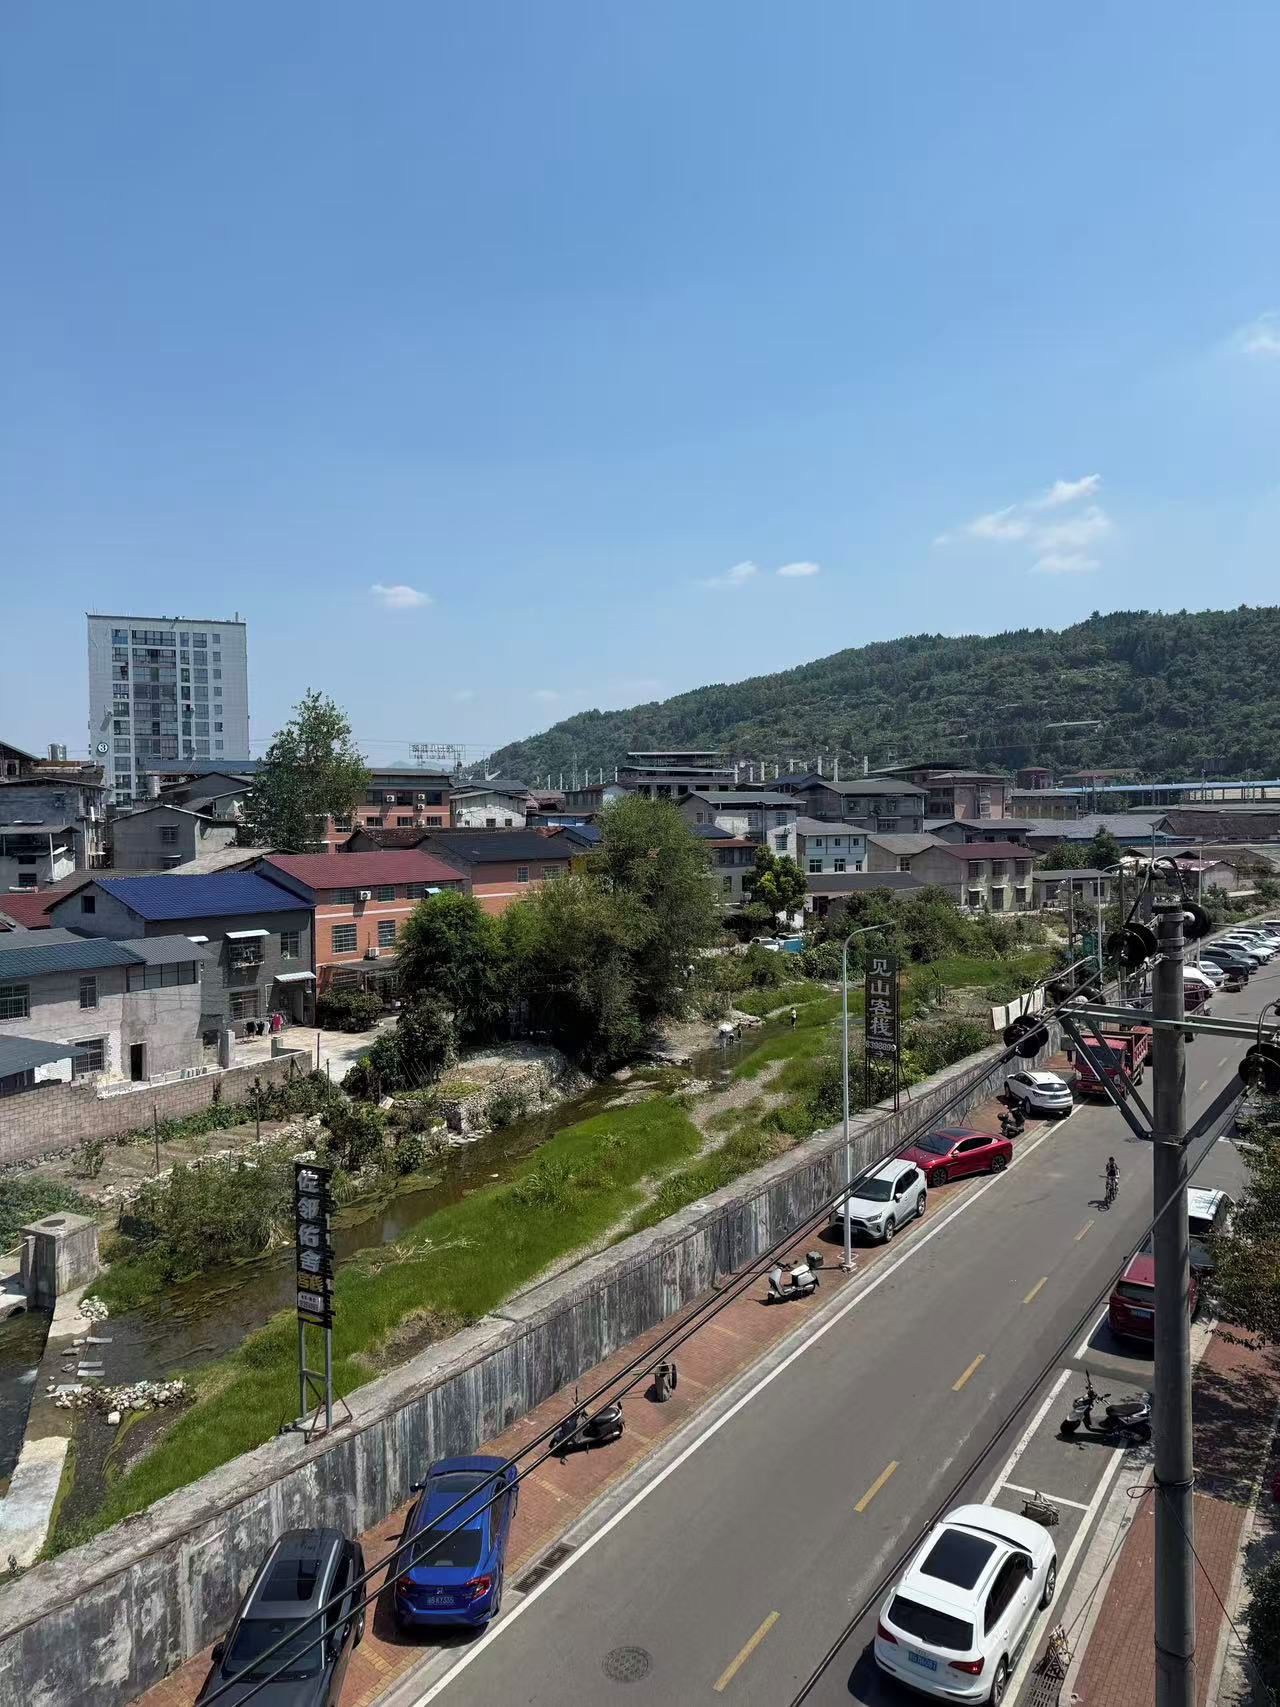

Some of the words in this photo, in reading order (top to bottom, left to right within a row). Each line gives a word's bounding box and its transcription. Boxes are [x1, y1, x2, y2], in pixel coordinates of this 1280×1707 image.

[869, 958, 893, 1037] 见山客栈
[297, 1169, 320, 1272] 佐邻佑舍
[298, 1271, 323, 1292] 客栈
